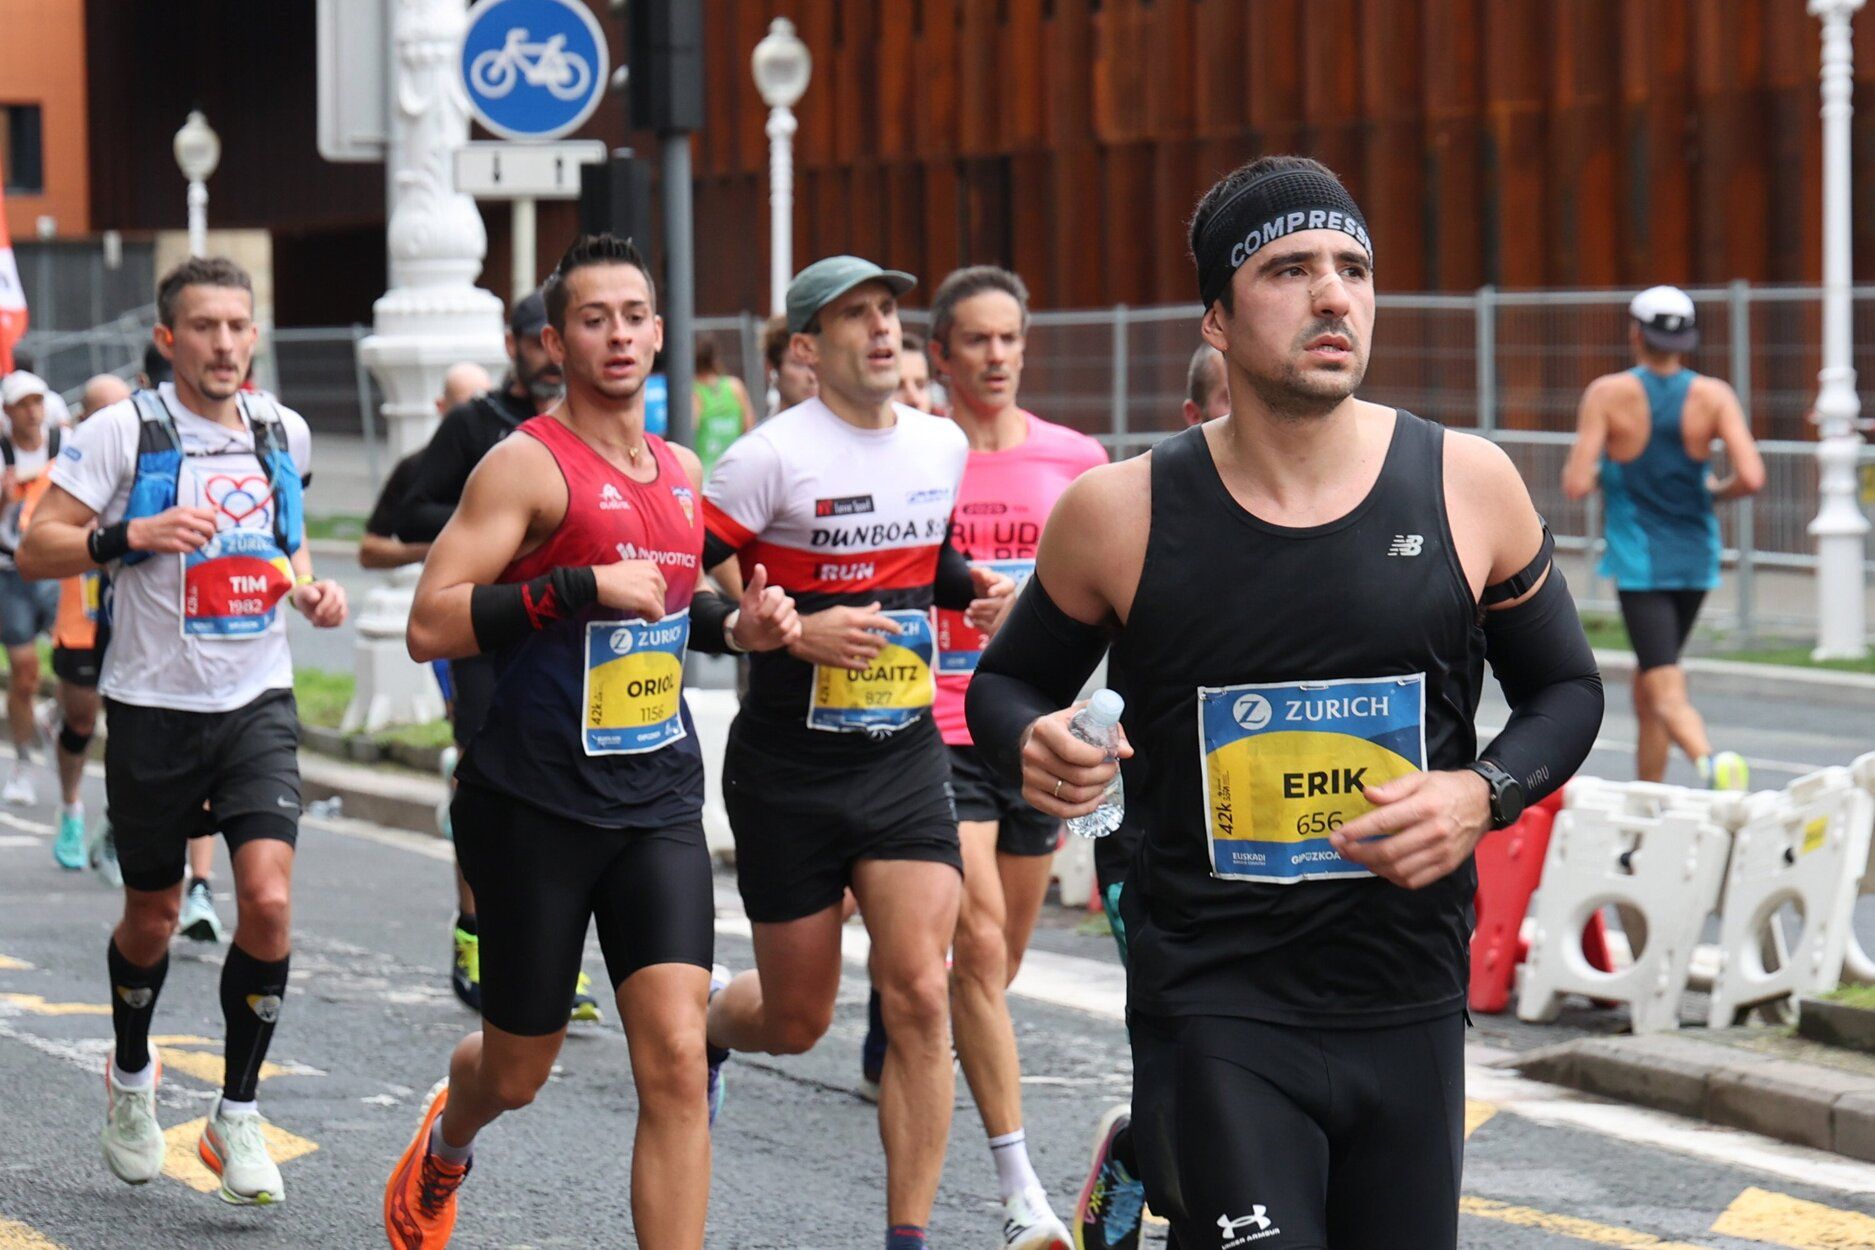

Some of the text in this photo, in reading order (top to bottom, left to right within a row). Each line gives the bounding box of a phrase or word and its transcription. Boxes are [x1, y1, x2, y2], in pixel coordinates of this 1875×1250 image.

[811, 521, 918, 547] DUNBOA
[228, 575, 268, 594] TIM
[227, 598, 264, 615] 1982
[627, 673, 674, 698] ORIOL
[865, 691, 892, 705] 827
[640, 703, 665, 723] 1156
[1285, 696, 1389, 721] ZURICH
[1284, 767, 1368, 799] ERIK
[1526, 764, 1550, 790] HIRU
[1215, 802, 1233, 836] 42k
[1296, 811, 1344, 836] 656
